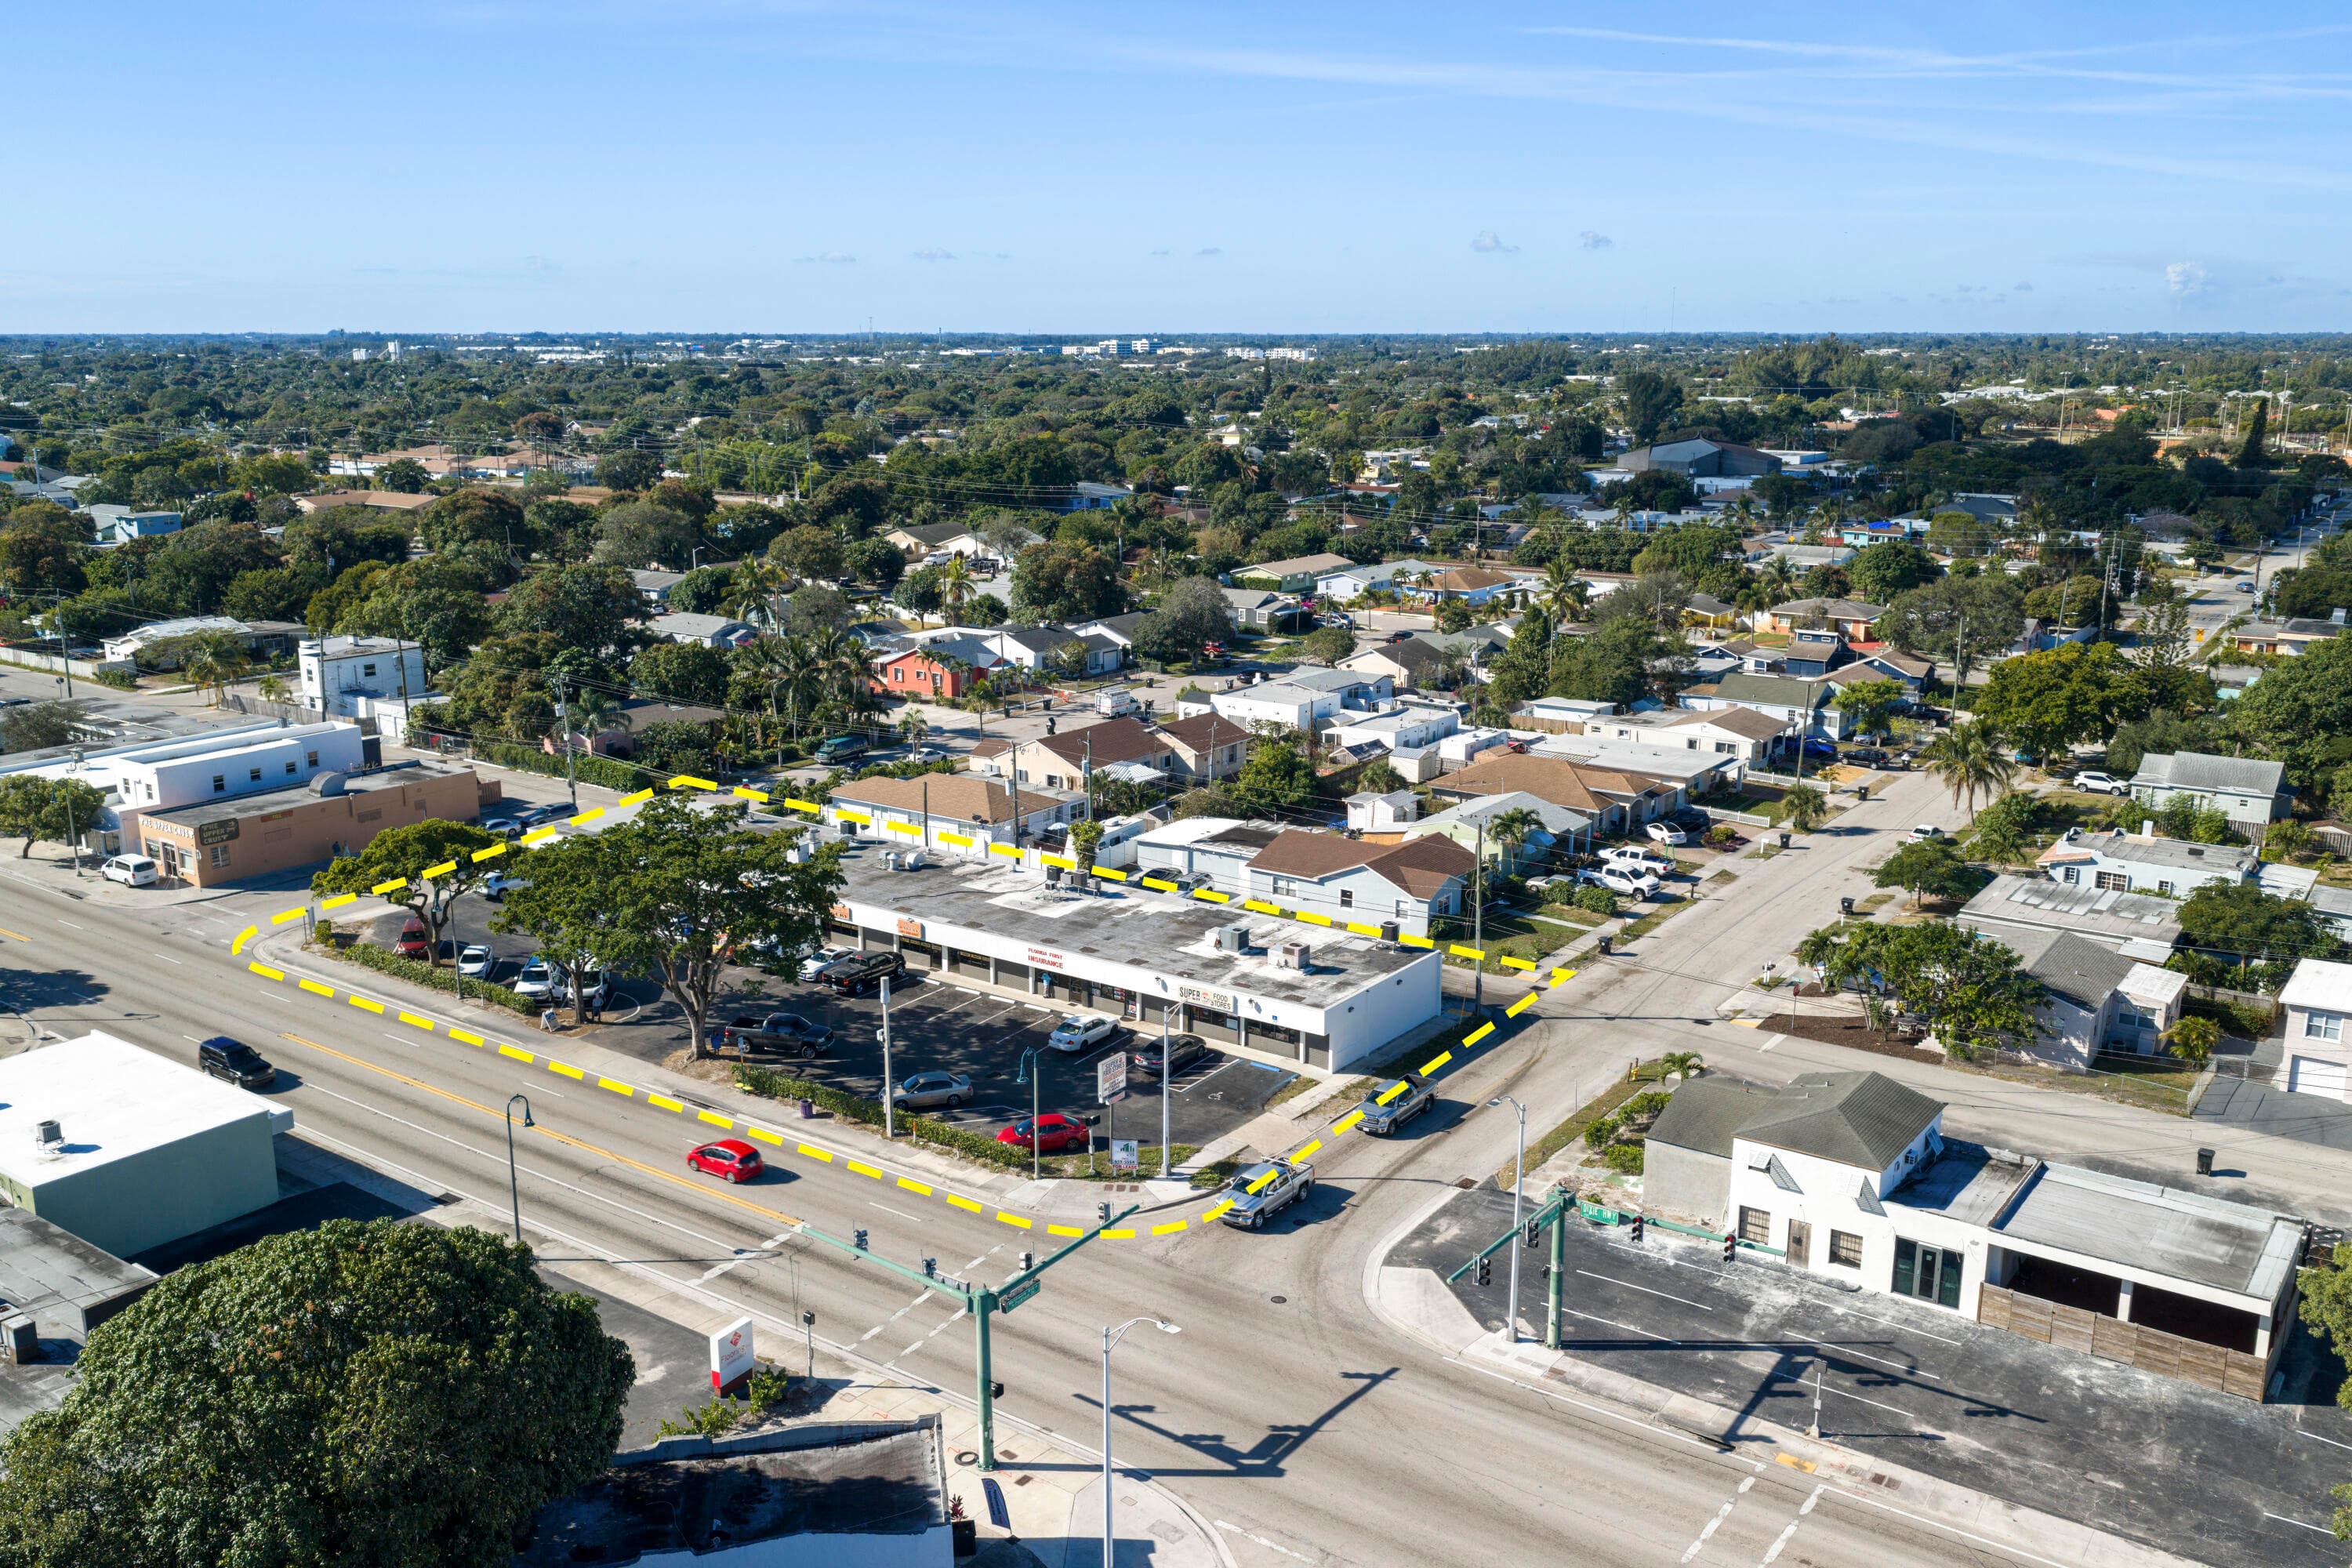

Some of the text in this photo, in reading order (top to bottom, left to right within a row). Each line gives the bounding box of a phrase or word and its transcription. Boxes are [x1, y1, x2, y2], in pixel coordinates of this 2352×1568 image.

[152, 821, 172, 833] UPPER
[174, 826, 194, 839] CRUST
[201, 822, 219, 831] THE
[203, 828, 225, 837] UPPER
[204, 834, 229, 844] CRUST
[1028, 955, 1063, 969] INSURANCE
[1179, 985, 1228, 1002] SUPER FOOD
[1210, 1000, 1231, 1010] STORES
[1584, 1203, 1617, 1220] DIXIE HWY
